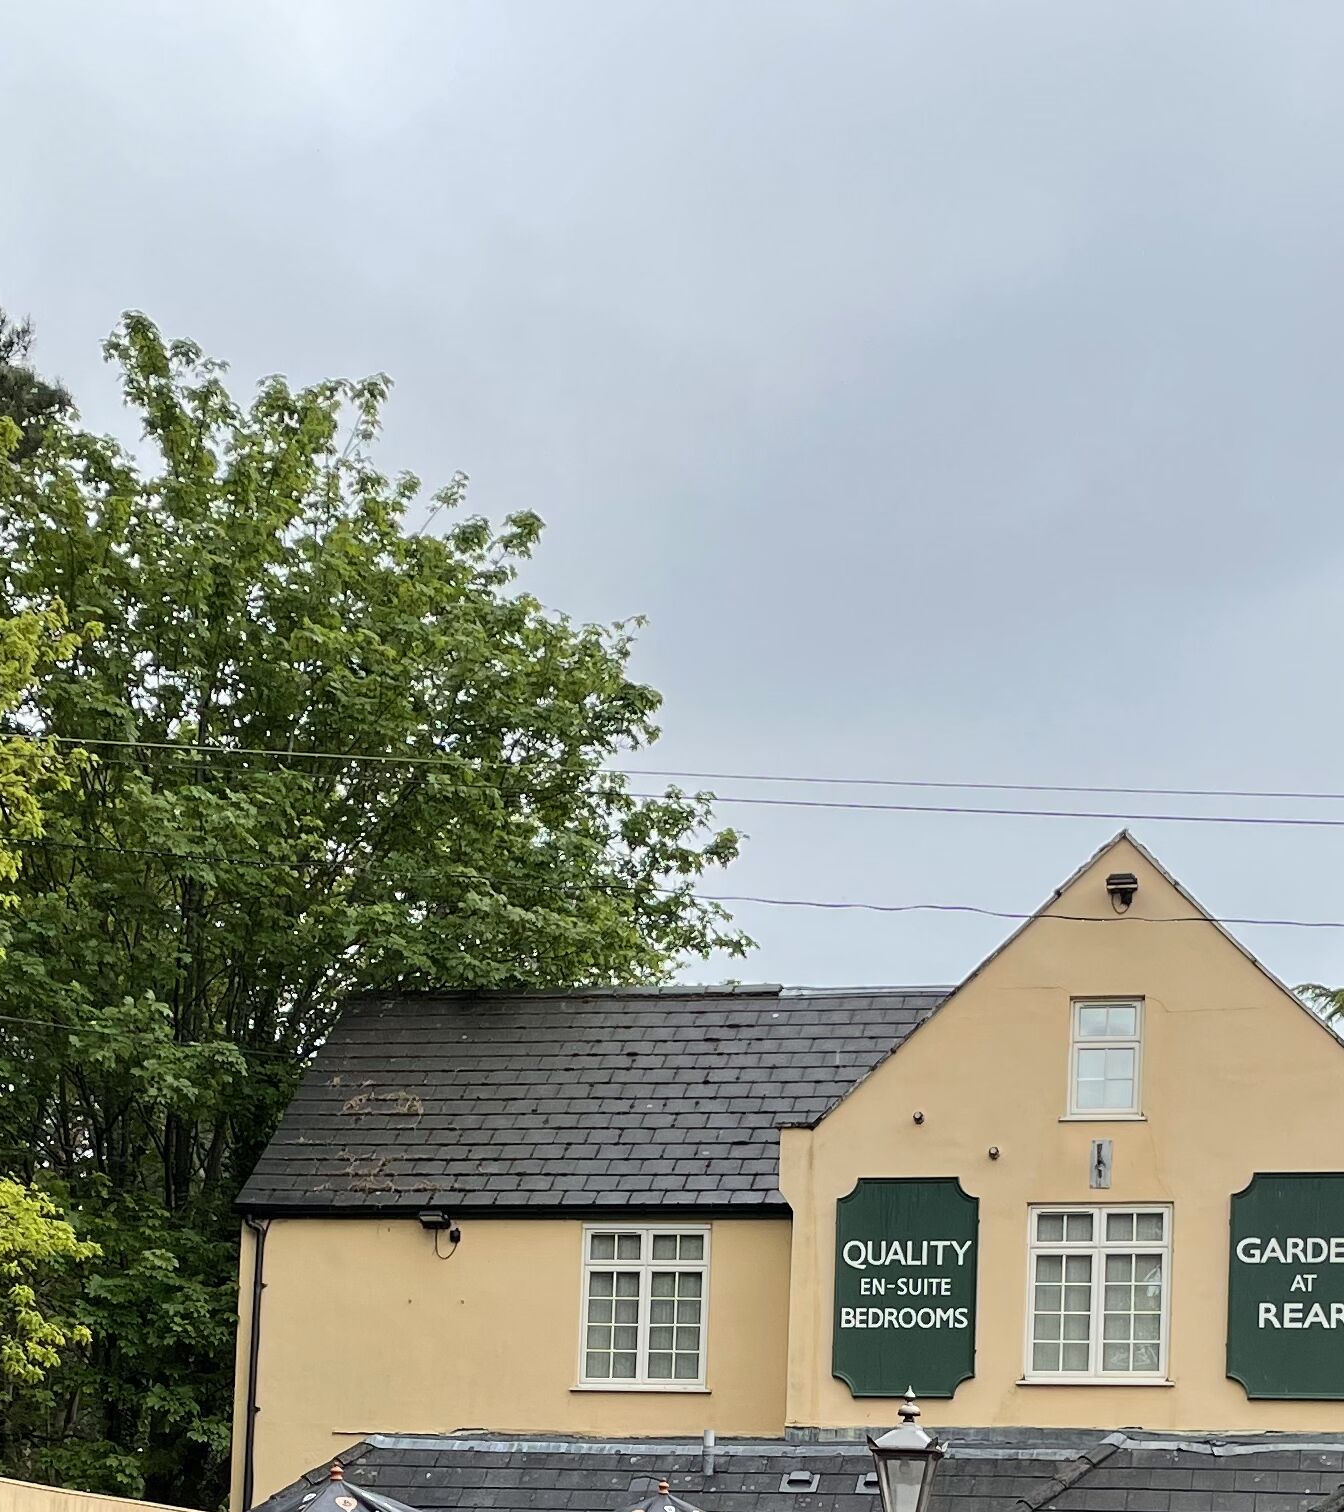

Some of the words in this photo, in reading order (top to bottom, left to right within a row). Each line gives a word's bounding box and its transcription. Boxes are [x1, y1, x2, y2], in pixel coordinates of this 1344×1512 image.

[842, 1240, 972, 1270] QUALITY
[860, 1277, 952, 1296] EN-SUITE
[1289, 1274, 1318, 1292] AT
[840, 1307, 969, 1329] BEDROOMS
